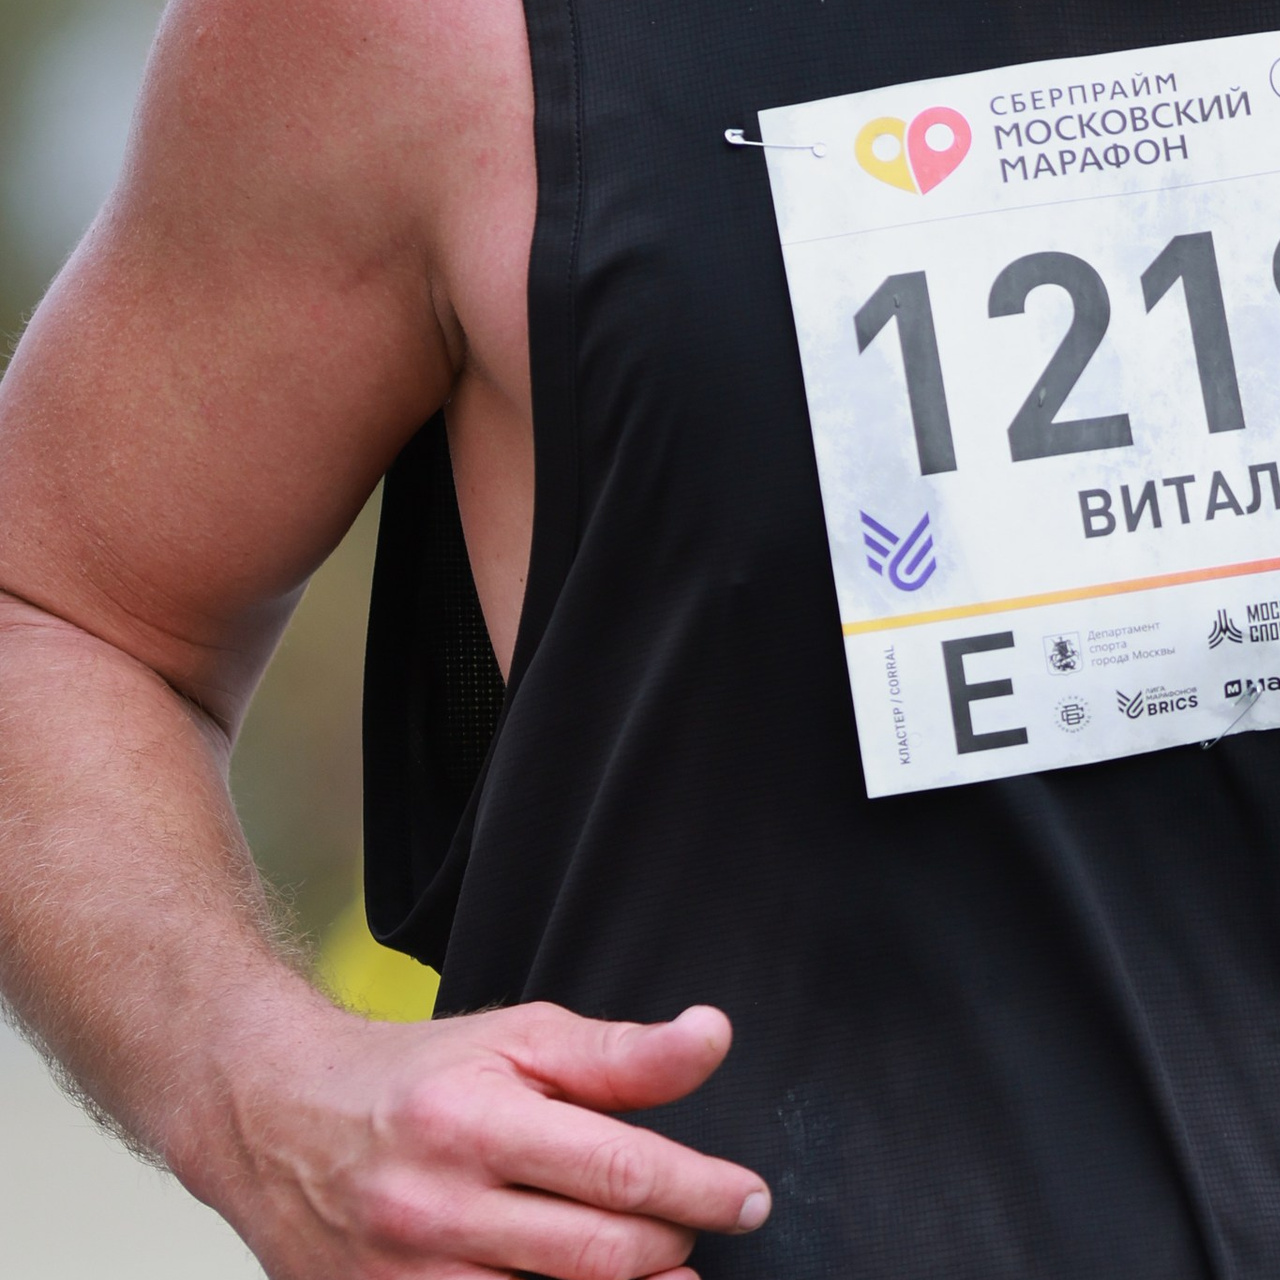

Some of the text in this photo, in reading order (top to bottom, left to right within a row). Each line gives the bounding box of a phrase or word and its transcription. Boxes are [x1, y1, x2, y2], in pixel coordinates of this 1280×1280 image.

[989, 72, 1178, 116] СБЕРПРАЙМ
[994, 86, 1252, 150] МОСКОВСКИЙ
[999, 135, 1189, 183] МАРАФОН
[1087, 622, 1161, 642] Департамент
[1089, 640, 1128, 654] спорта
[1091, 645, 1176, 668] города Москвы
[884, 644, 901, 696] CORRAL
[1145, 685, 1166, 695] ЛИГА
[1145, 686, 1198, 701] МАРАФОНОВ
[1147, 695, 1198, 716] BRICS
[892, 707, 911, 765] КЛАСТЕР
